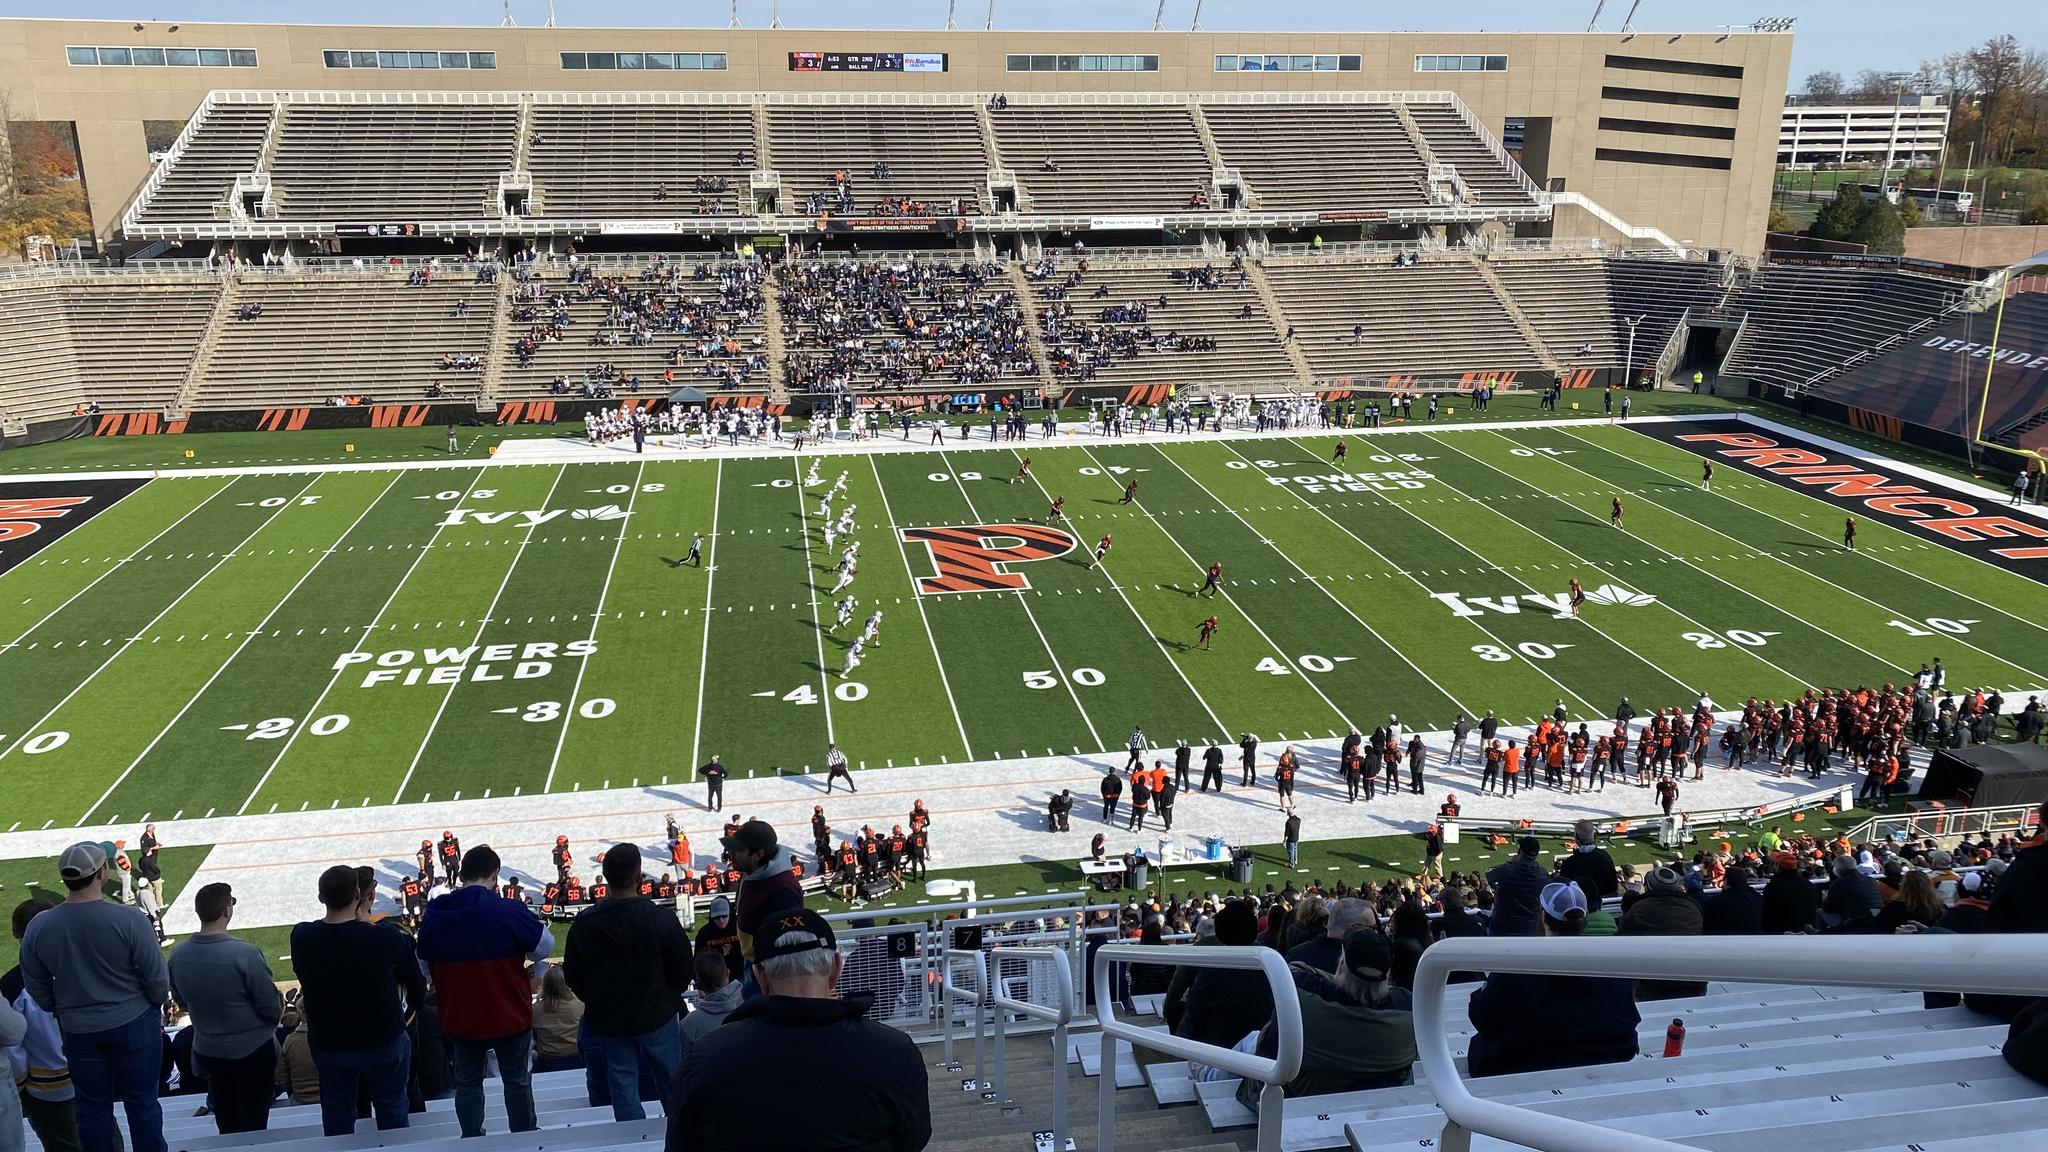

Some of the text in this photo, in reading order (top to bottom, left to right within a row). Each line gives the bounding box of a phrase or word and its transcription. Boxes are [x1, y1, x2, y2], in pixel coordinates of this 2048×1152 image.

[1922, 336, 2048, 371] DEFENDE
[1264, 470, 1436, 486] POWERS
[1303, 480, 1427, 494] FIELD
[434, 508, 568, 528] Ivy
[898, 524, 1078, 595] P
[1430, 592, 1580, 619] Ivy
[1886, 617, 1970, 637] 10
[1682, 629, 1767, 650] 20
[332, 640, 599, 670] POWERS
[1471, 642, 1556, 662] 30
[1255, 655, 1335, 675] 40
[360, 661, 553, 688] FIELD
[1022, 668, 1106, 690] 50
[782, 682, 869, 705] 40
[515, 698, 616, 722] 30
[245, 714, 351, 741] 20
[22, 732, 70, 755] 0
[1616, 741, 1626, 750] 77
[1352, 760, 1360, 769] 41
[1283, 771, 1290, 779] 15
[444, 847, 456, 857] 55
[868, 843, 876, 853] 21
[843, 853, 854, 864] 43
[728, 870, 740, 881] 95
[406, 884, 418, 896] 53
[706, 878, 718, 889] 92
[507, 889, 514, 900] 11
[547, 887, 560, 900] 17
[568, 889, 580, 900] 56
[594, 887, 606, 898] 33
[779, 916, 806, 929] XX
[1957, 1080, 1971, 1089] 16
[1831, 1094, 1844, 1102] 17
[1035, 1133, 1054, 1141] 33
[1419, 1139, 1434, 1148] 20
[1908, 1144, 1925, 1152] 18
